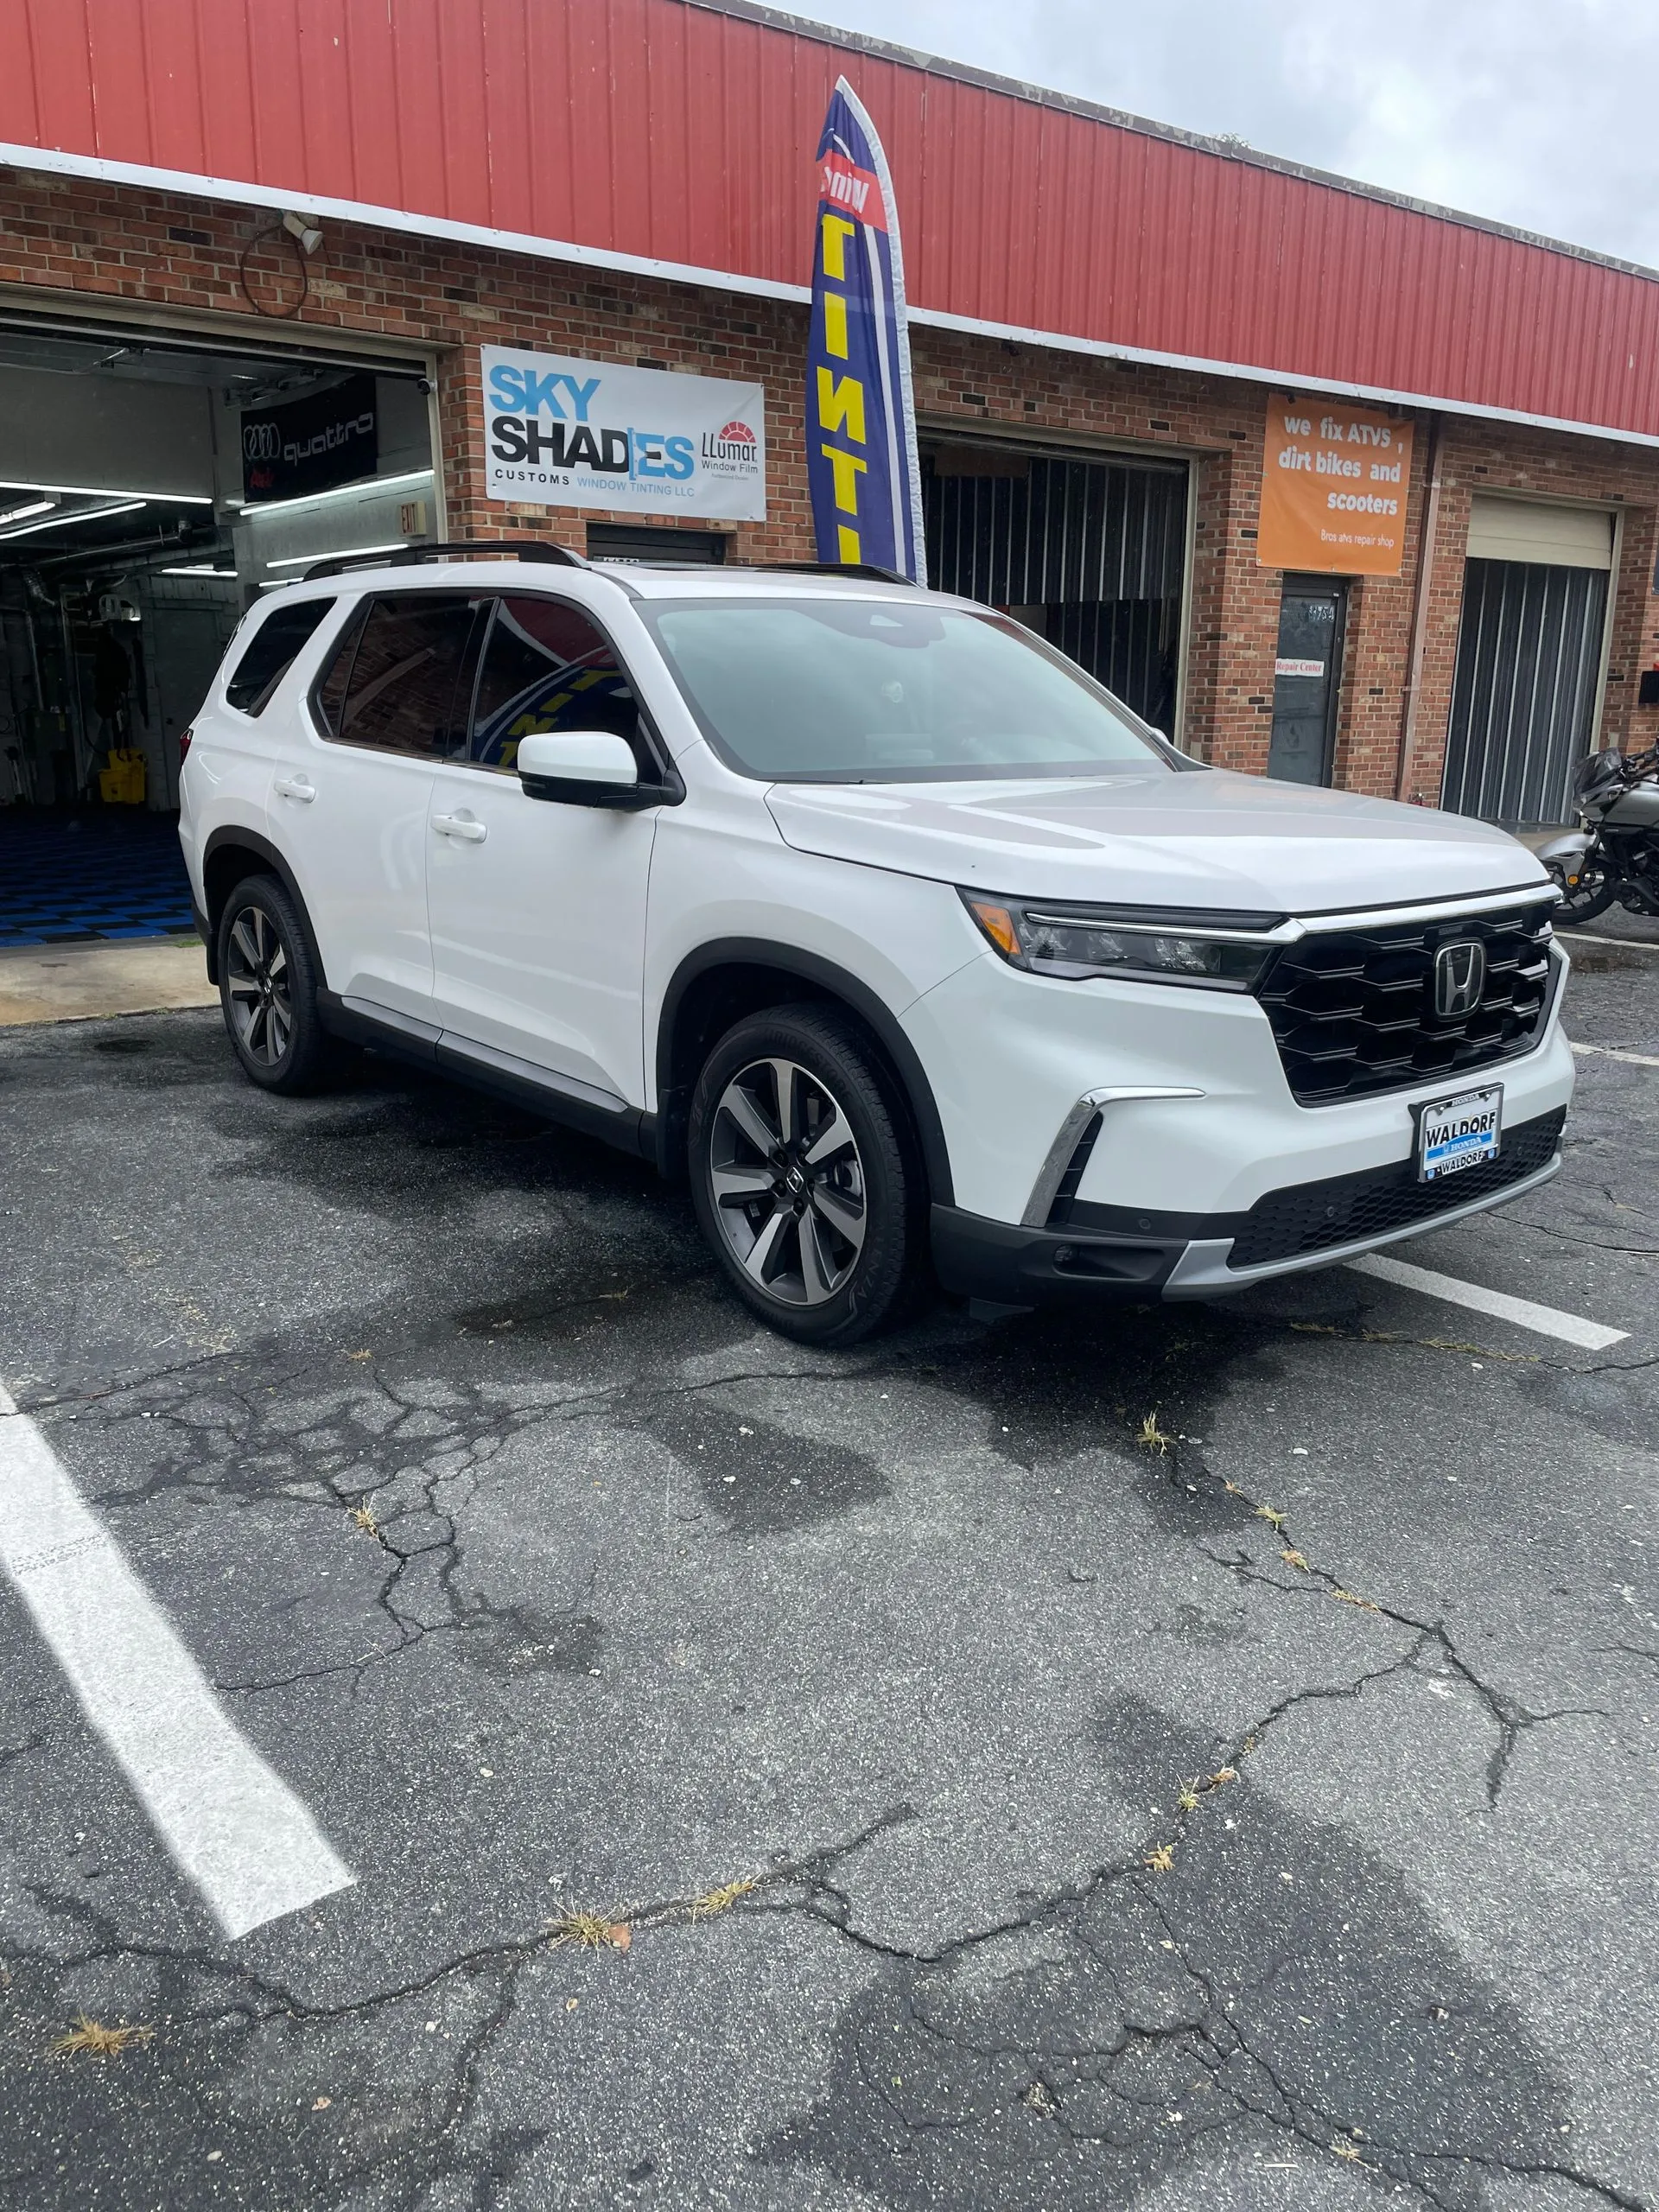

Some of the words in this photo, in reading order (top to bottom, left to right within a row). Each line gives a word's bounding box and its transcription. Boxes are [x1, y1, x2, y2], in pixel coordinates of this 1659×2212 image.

[488, 365, 602, 422] SKY
[283, 411, 374, 467] quattro
[1284, 416, 1312, 436] we
[1320, 416, 1344, 442] fix
[491, 416, 695, 481] SHADES
[702, 432, 758, 462] LLumar
[702, 460, 736, 472] Window
[740, 463, 758, 474] Film
[1279, 445, 1312, 472] dirt
[1315, 451, 1362, 478] bikes
[1370, 462, 1402, 483] and
[495, 468, 570, 486] CUSTOMS
[576, 476, 627, 492] WINDOW
[630, 482, 672, 496] TINTING
[675, 486, 695, 498] LLC
[1326, 492, 1398, 516] scooters
[1320, 528, 1338, 543] Bros
[1354, 534, 1376, 548] repair
[1377, 534, 1395, 550] shop
[1276, 661, 1298, 673] Repair
[1300, 662, 1322, 672] Center
[1452, 1093, 1480, 1107] HONDA
[1426, 1111, 1497, 1148] WALDORF
[1451, 1136, 1482, 1151] HONDA
[1441, 1150, 1484, 1174] WALDORF
